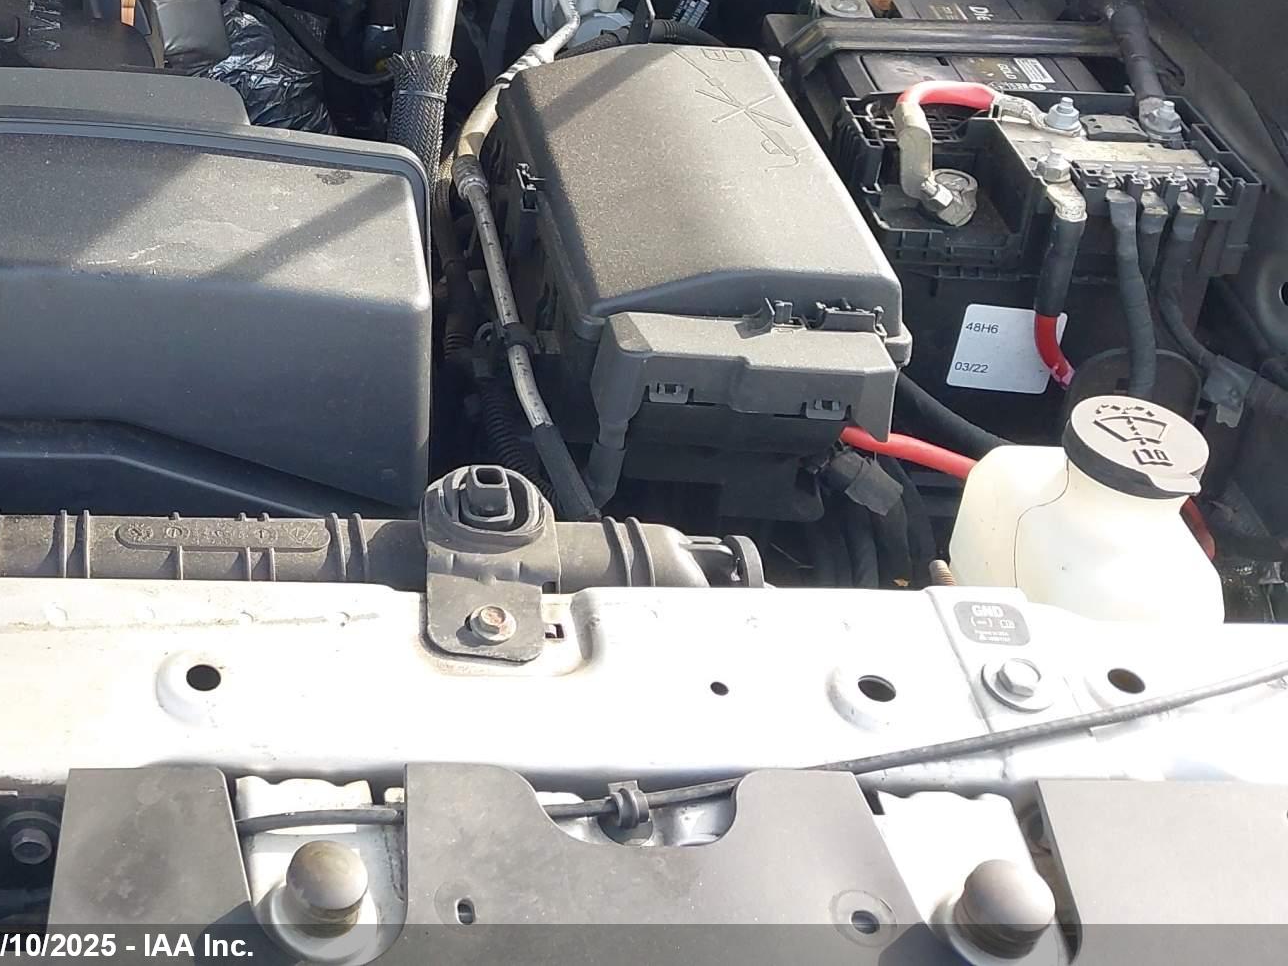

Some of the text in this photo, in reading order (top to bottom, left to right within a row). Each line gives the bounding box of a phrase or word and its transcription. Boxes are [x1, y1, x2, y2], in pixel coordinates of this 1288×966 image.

[965, 321, 999, 334] 48H6
[954, 361, 989, 374] 03/22
[971, 604, 1004, 618] GND
